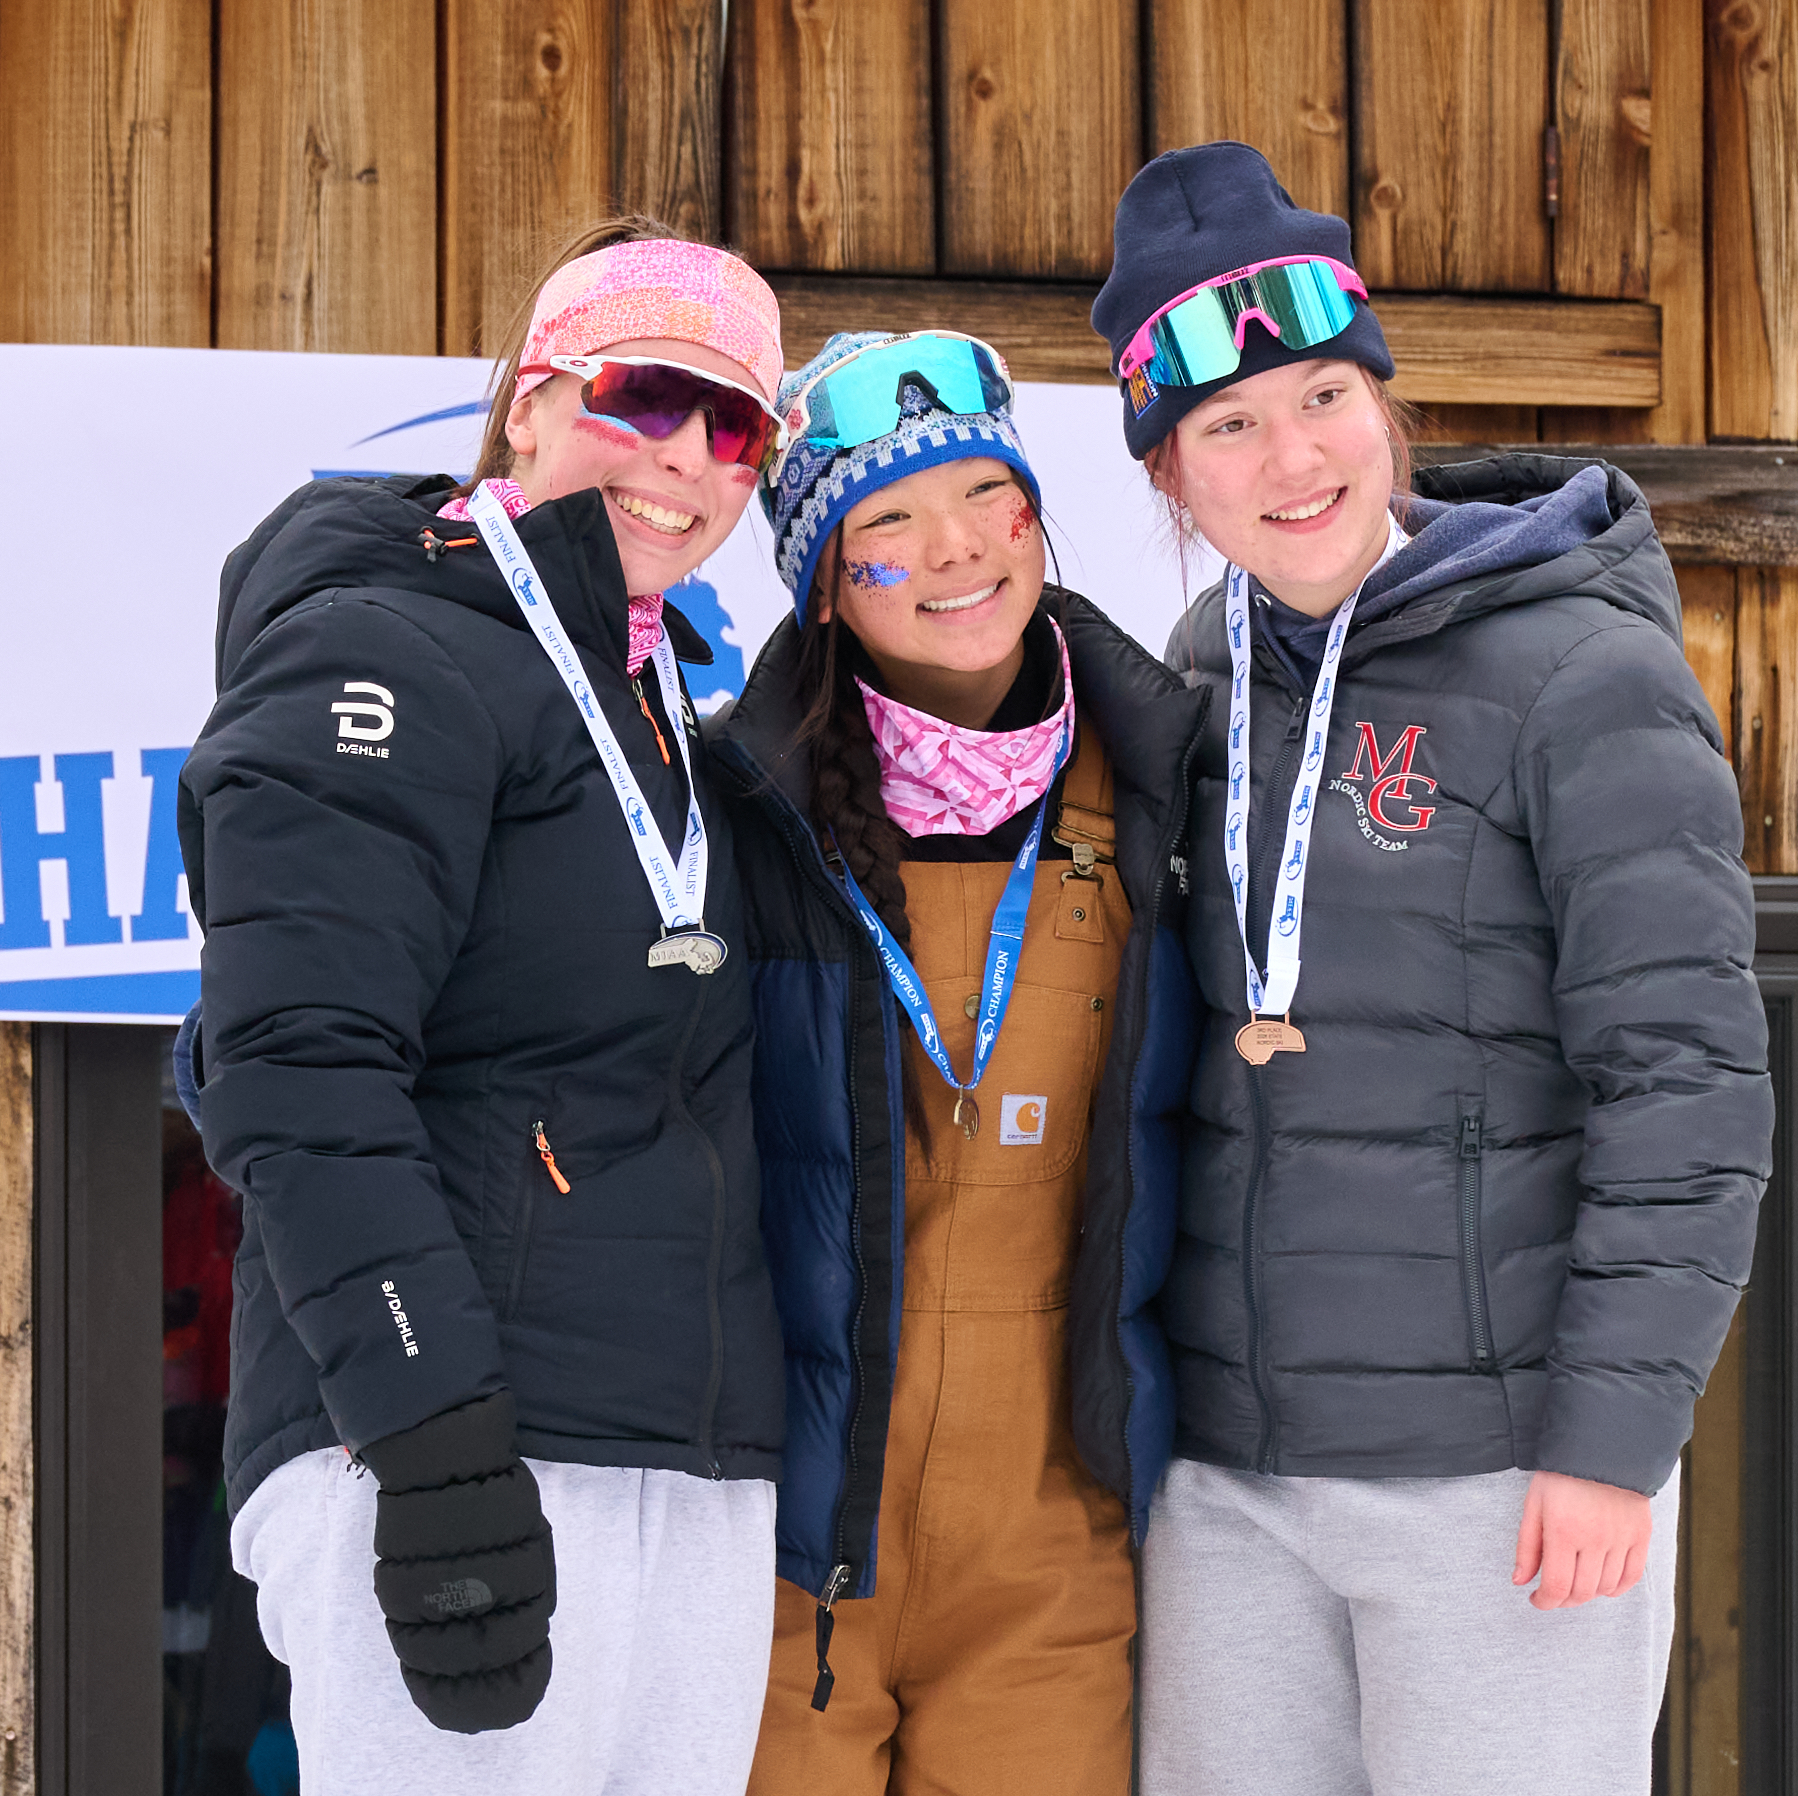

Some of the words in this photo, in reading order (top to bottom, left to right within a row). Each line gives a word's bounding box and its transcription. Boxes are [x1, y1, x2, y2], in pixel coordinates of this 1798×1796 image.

[485, 516, 516, 563] FINALIST
[541, 625, 575, 674] FINALIST
[600, 738, 629, 790] FINALIST
[1328, 780, 1366, 816] NORDIC
[1372, 834, 1409, 852] TEAM
[649, 856, 679, 909] FINALIST
[880, 946, 922, 1008] CHAMPION
[987, 950, 1010, 1018] CHAMPION
[438, 1598, 471, 1613] FACE
[440, 1579, 467, 1592] THE
